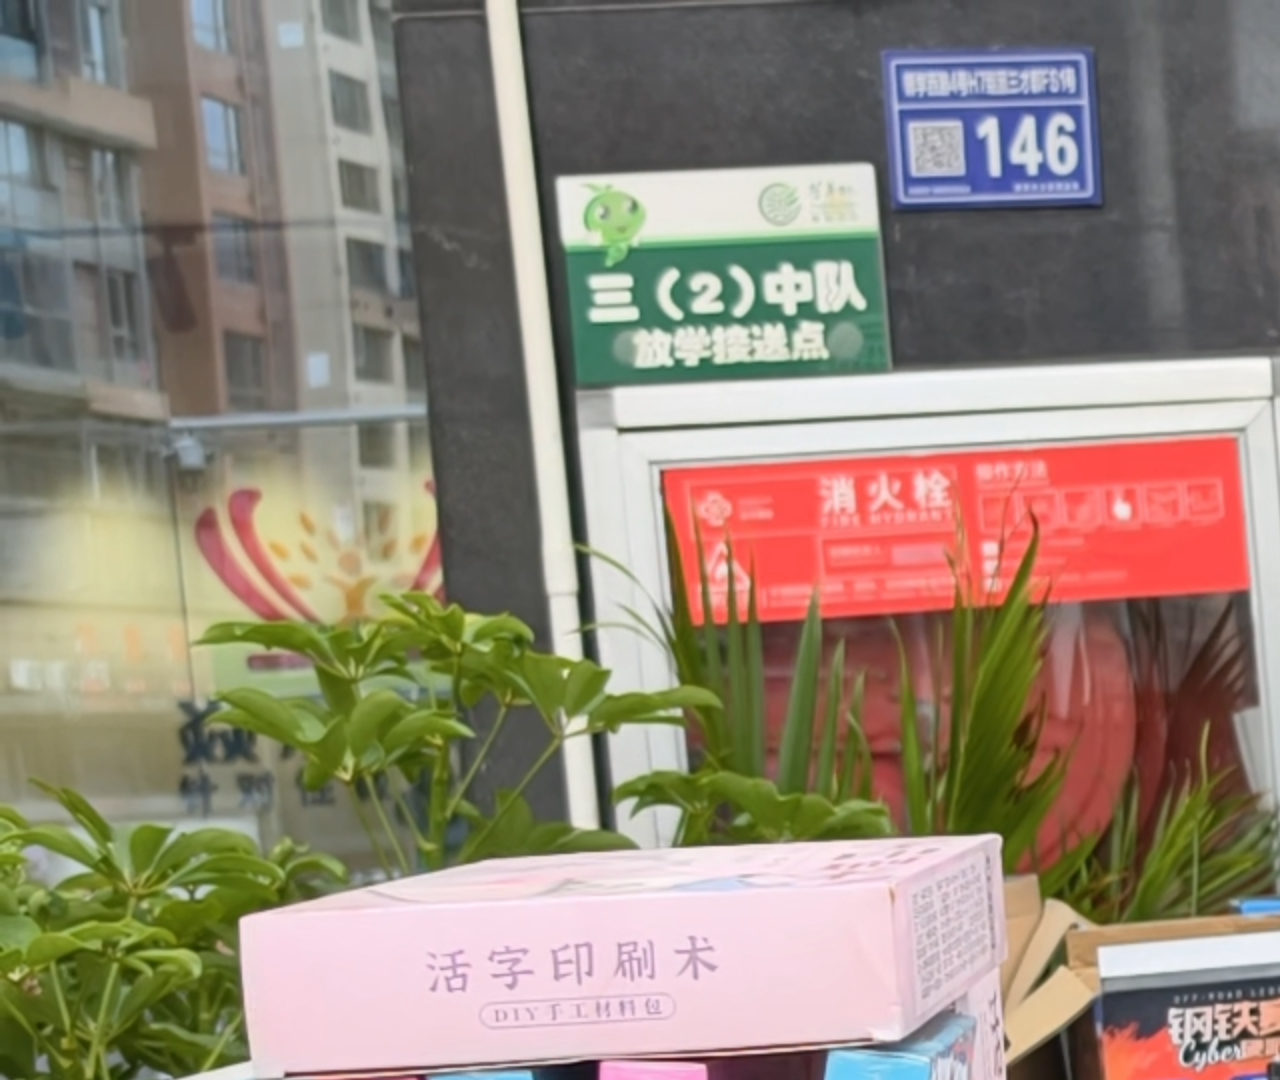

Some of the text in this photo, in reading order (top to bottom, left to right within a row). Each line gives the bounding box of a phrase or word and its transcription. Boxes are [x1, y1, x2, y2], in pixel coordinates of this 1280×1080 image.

[976, 112, 1079, 178] 146
[632, 320, 831, 369] 放学接送点
[819, 469, 952, 517] 消火栓
[426, 935, 719, 993] 活字印刷术
[493, 997, 665, 1024] DIY手工材料包
